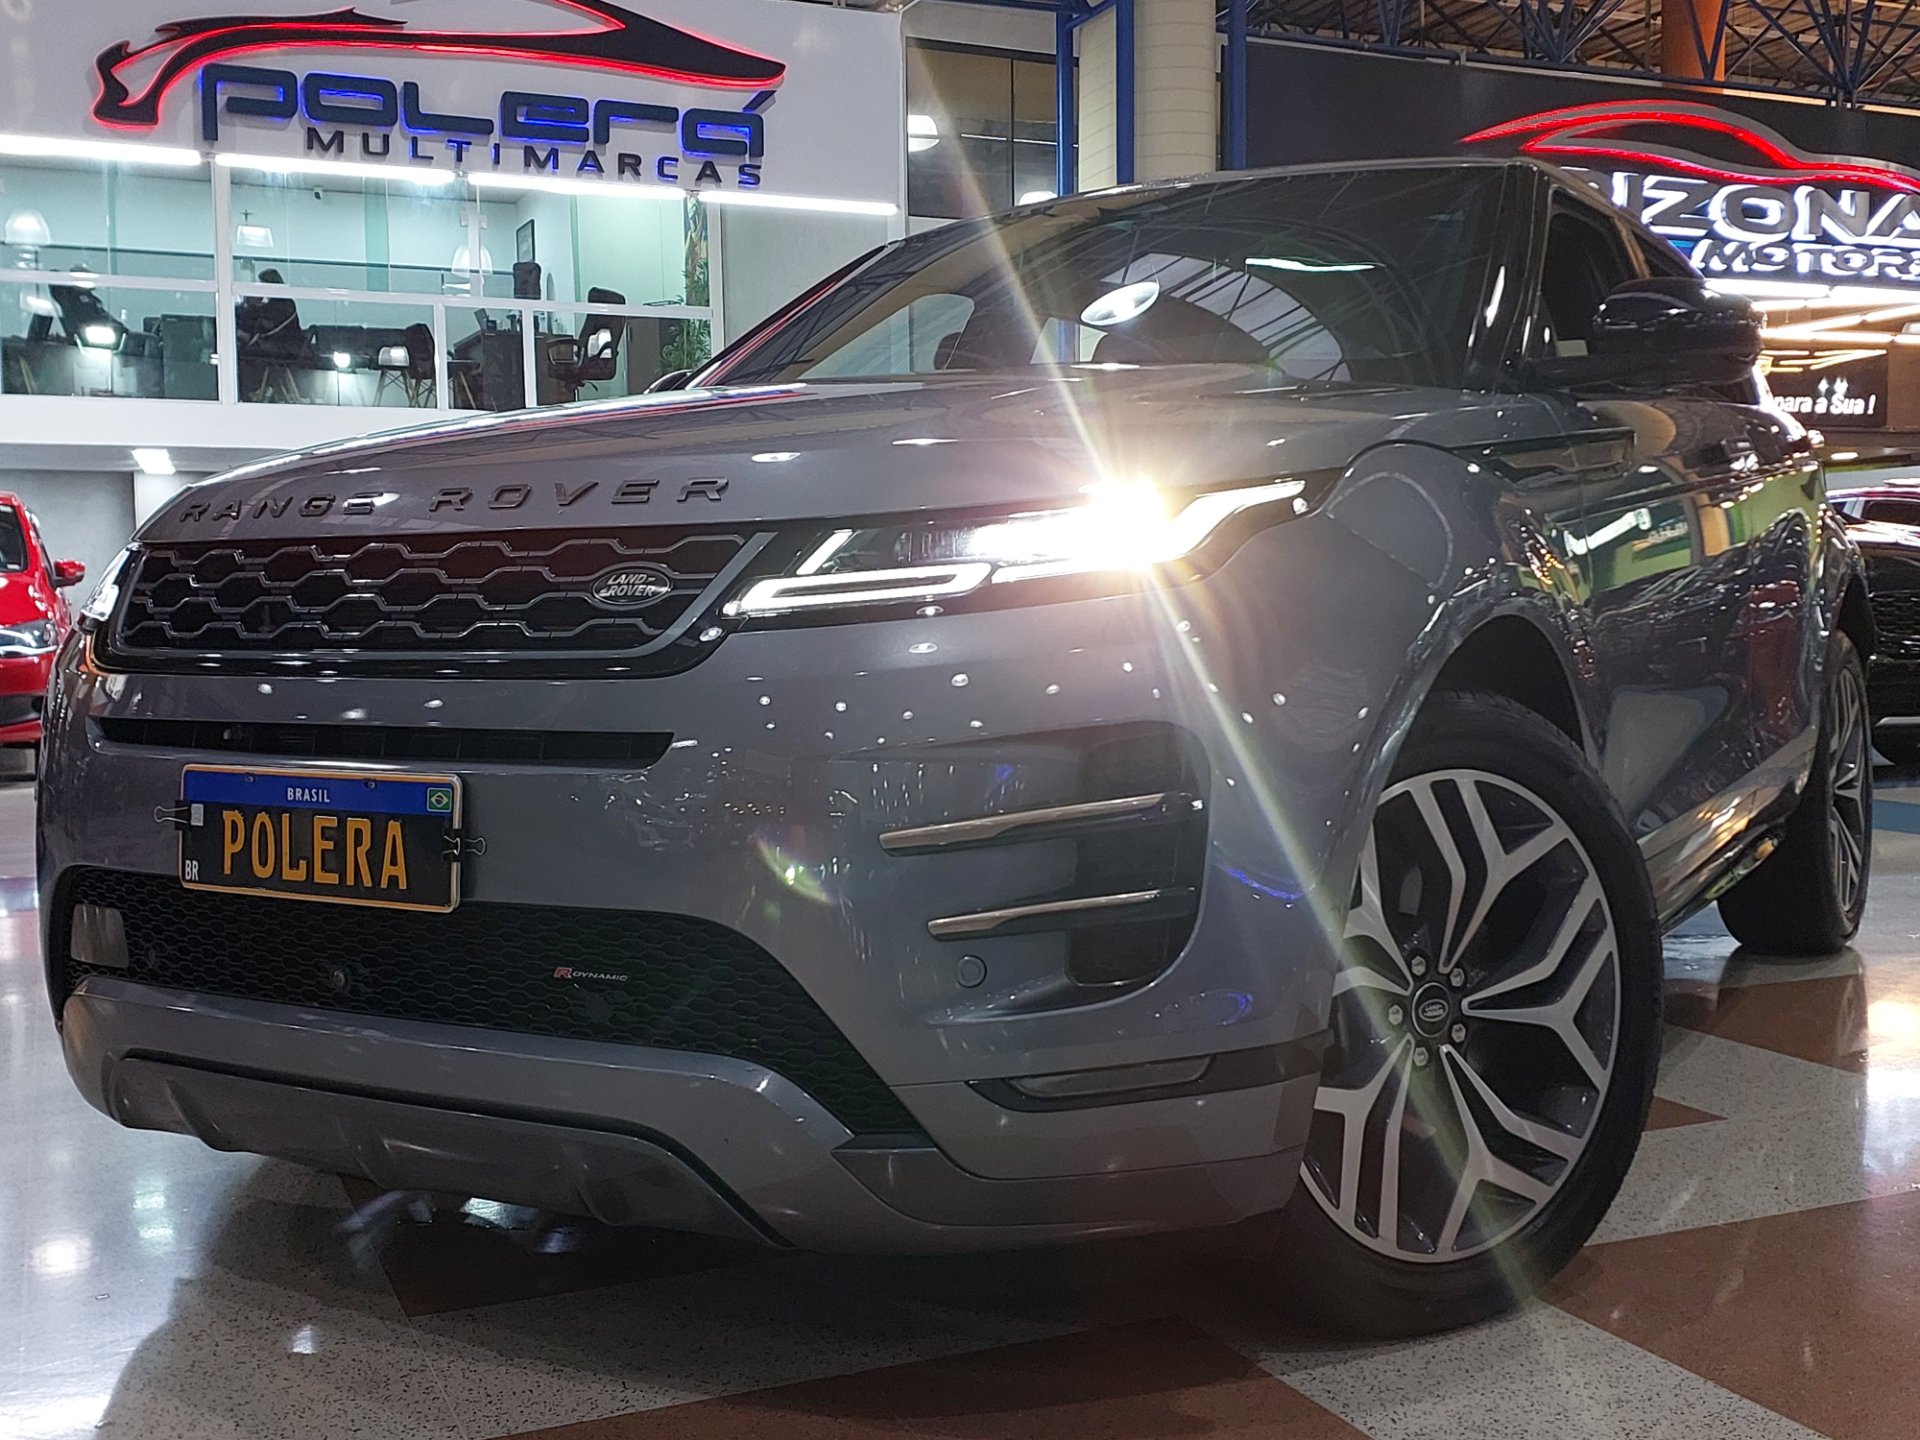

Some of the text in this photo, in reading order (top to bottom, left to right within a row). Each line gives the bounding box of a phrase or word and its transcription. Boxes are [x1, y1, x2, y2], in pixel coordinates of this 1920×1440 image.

[306, 126, 762, 187] MULTIMARCAS
[1693, 240, 1920, 280] MOTOR
[1830, 394, 1865, 415] Sua
[179, 476, 729, 523] RANGE ROVER
[607, 573, 648, 585] LAND
[608, 584, 656, 597] ROVER
[287, 787, 331, 803] BRASIL
[222, 809, 407, 890] POLERA
[184, 859, 200, 882] BR
